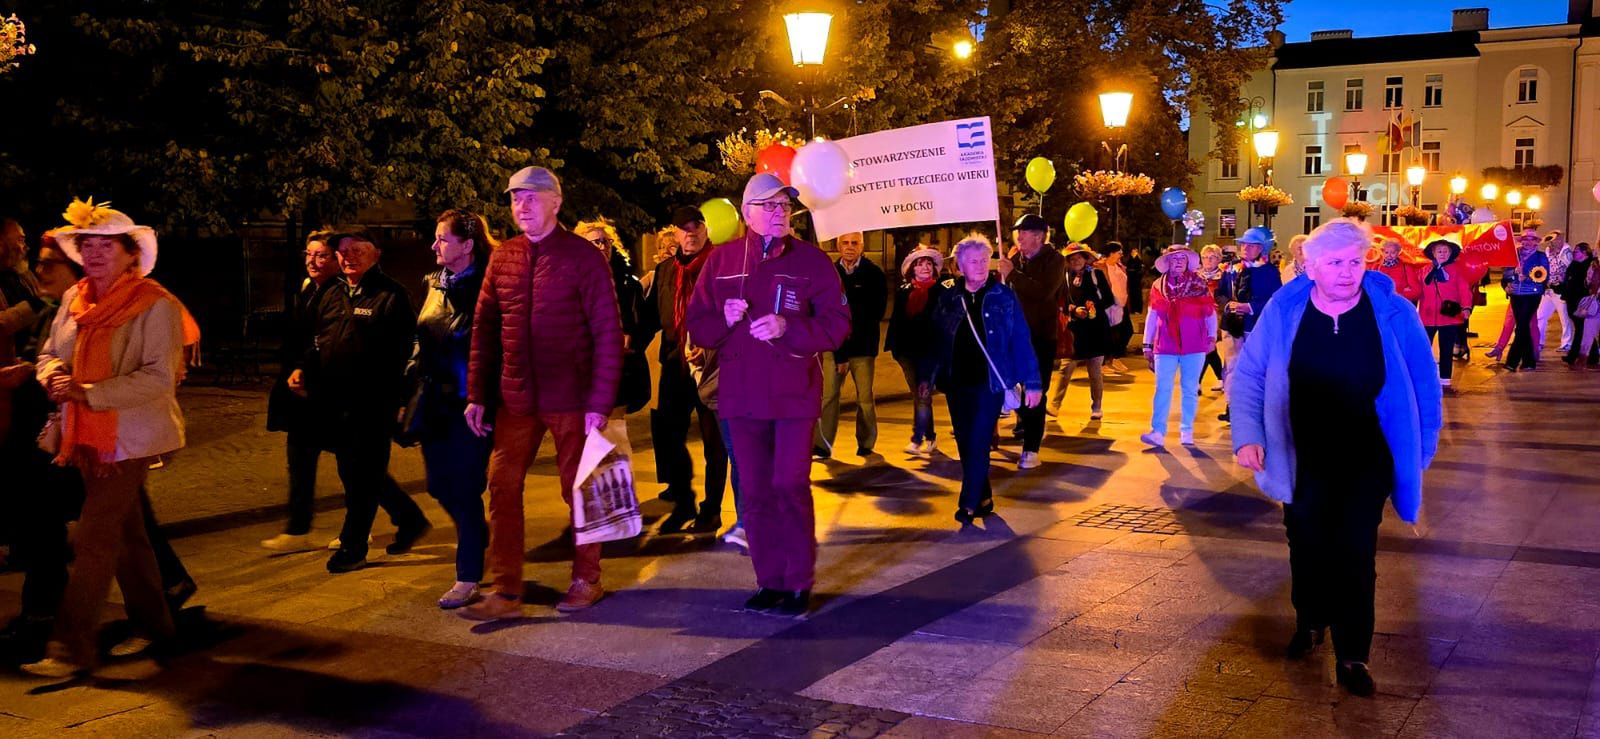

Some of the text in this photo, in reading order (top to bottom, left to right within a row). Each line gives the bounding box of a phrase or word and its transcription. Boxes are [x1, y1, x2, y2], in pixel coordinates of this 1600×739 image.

[853, 147, 946, 168] STOWARZYSZENIE
[847, 169, 990, 195] RSYTETU TRZECIEGO WIEKU
[881, 201, 934, 214] W PŁOCKU
